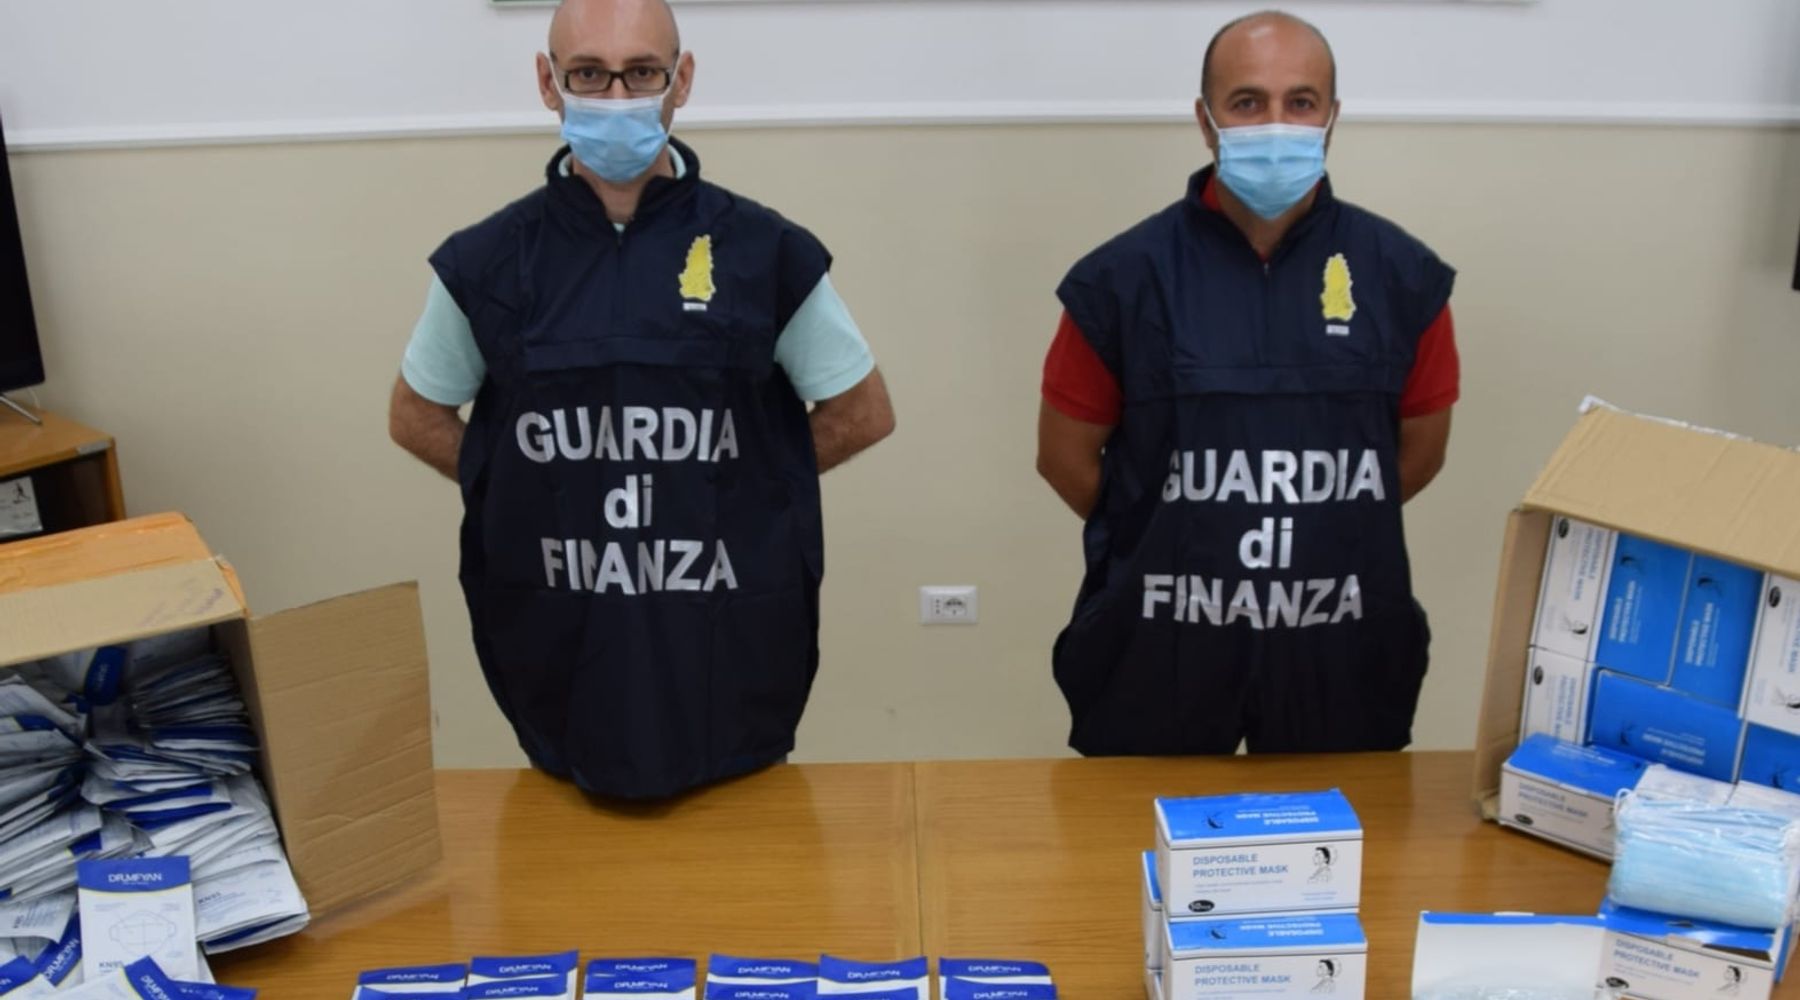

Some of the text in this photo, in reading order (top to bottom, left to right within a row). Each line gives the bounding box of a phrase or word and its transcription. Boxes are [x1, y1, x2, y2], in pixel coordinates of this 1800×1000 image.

[516, 406, 739, 463] GUARDIA
[604, 473, 653, 528] di
[541, 537, 738, 595] FINANZA
[1238, 517, 1293, 569] di
[1143, 574, 1363, 629] FINANZA
[1193, 854, 1259, 865] DISPOSABLE
[1193, 865, 1288, 878] PROTECTIVE MASK
[1195, 964, 1259, 974] DISPOSABLE
[1195, 975, 1291, 986] PROTECTIVE MASK
